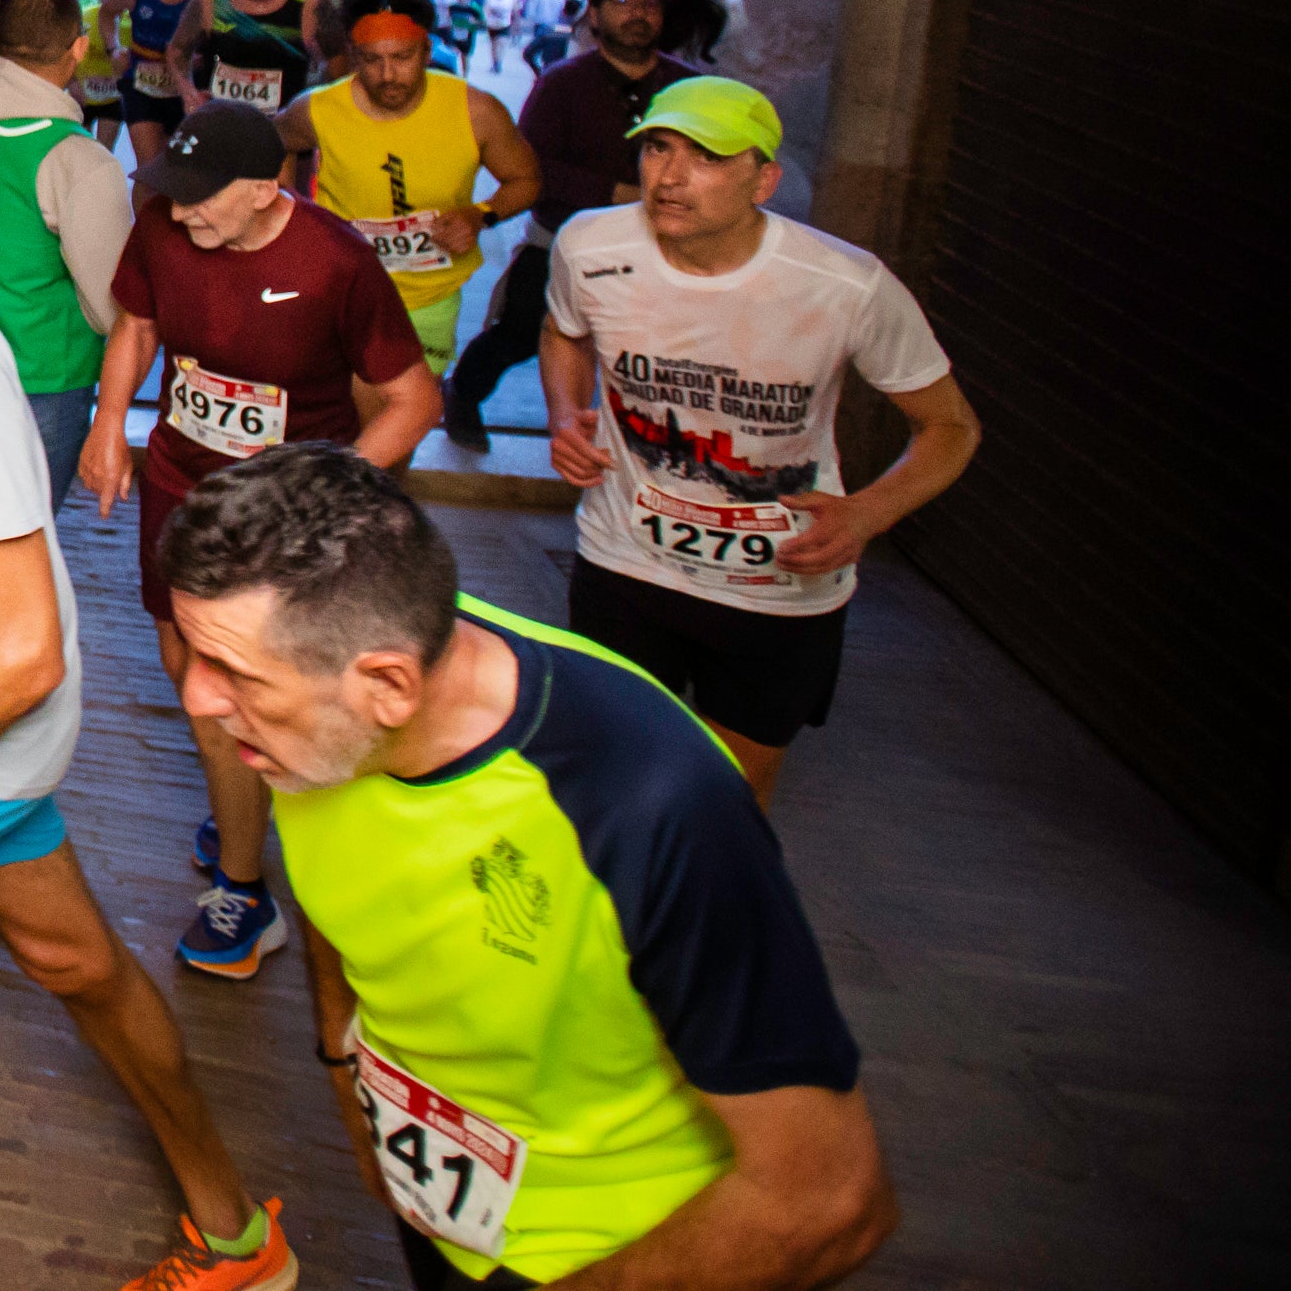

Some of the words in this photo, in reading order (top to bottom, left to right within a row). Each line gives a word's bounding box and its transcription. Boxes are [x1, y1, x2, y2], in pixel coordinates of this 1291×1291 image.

[218, 78, 270, 101] 1064
[374, 231, 433, 256] 892
[614, 350, 650, 383] 40
[622, 381, 685, 405] CIUDAD
[689, 391, 716, 412] DE
[654, 368, 716, 392] MEDIA
[721, 377, 815, 405] MARATÓN
[174, 382, 264, 436] 4976
[641, 514, 775, 566] 1279
